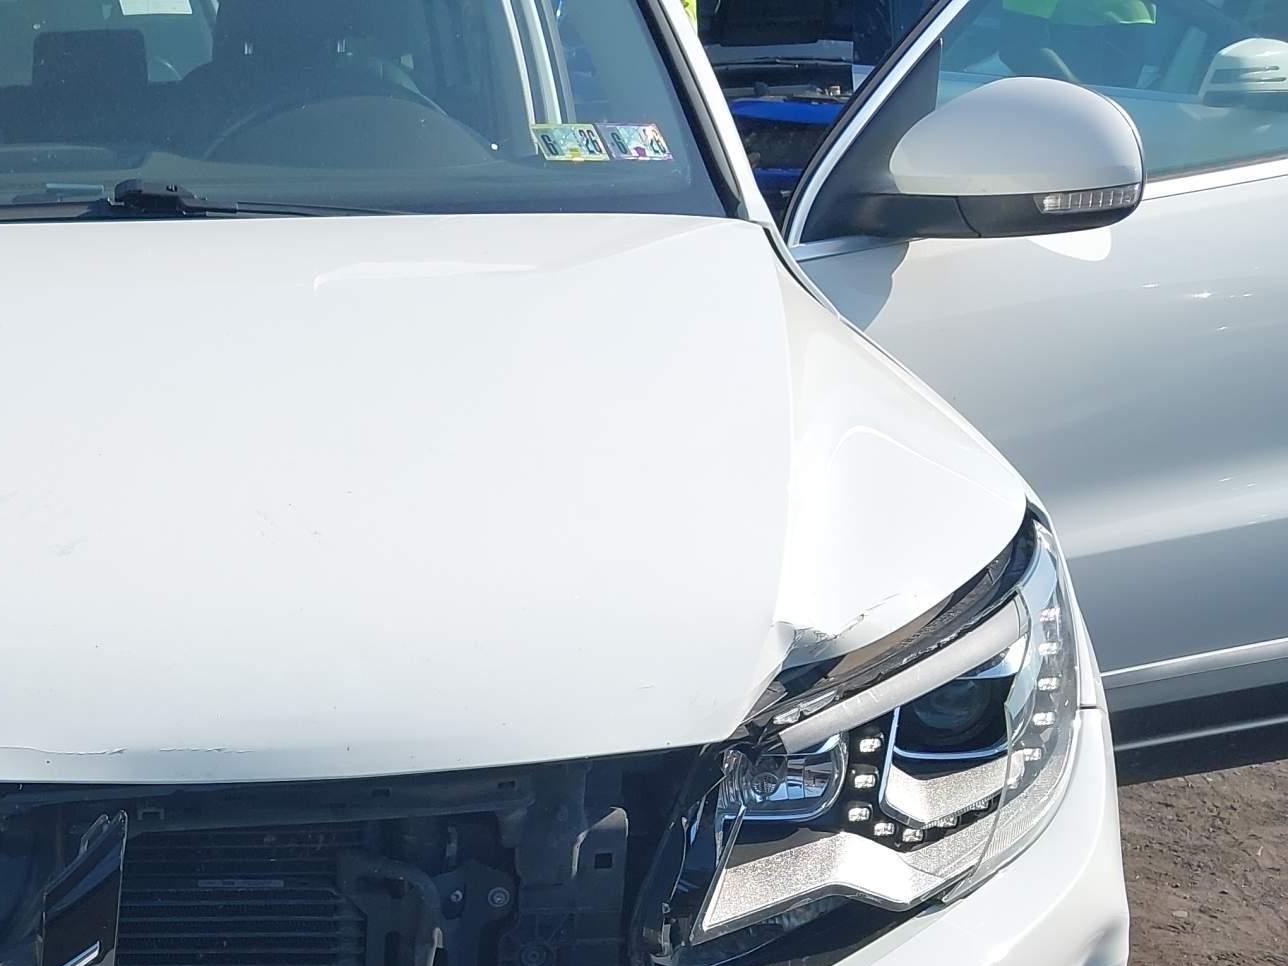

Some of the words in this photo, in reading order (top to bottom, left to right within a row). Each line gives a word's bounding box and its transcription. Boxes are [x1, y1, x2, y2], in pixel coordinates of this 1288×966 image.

[541, 134, 559, 156] 6
[579, 129, 602, 154] 26
[611, 132, 627, 155] 6
